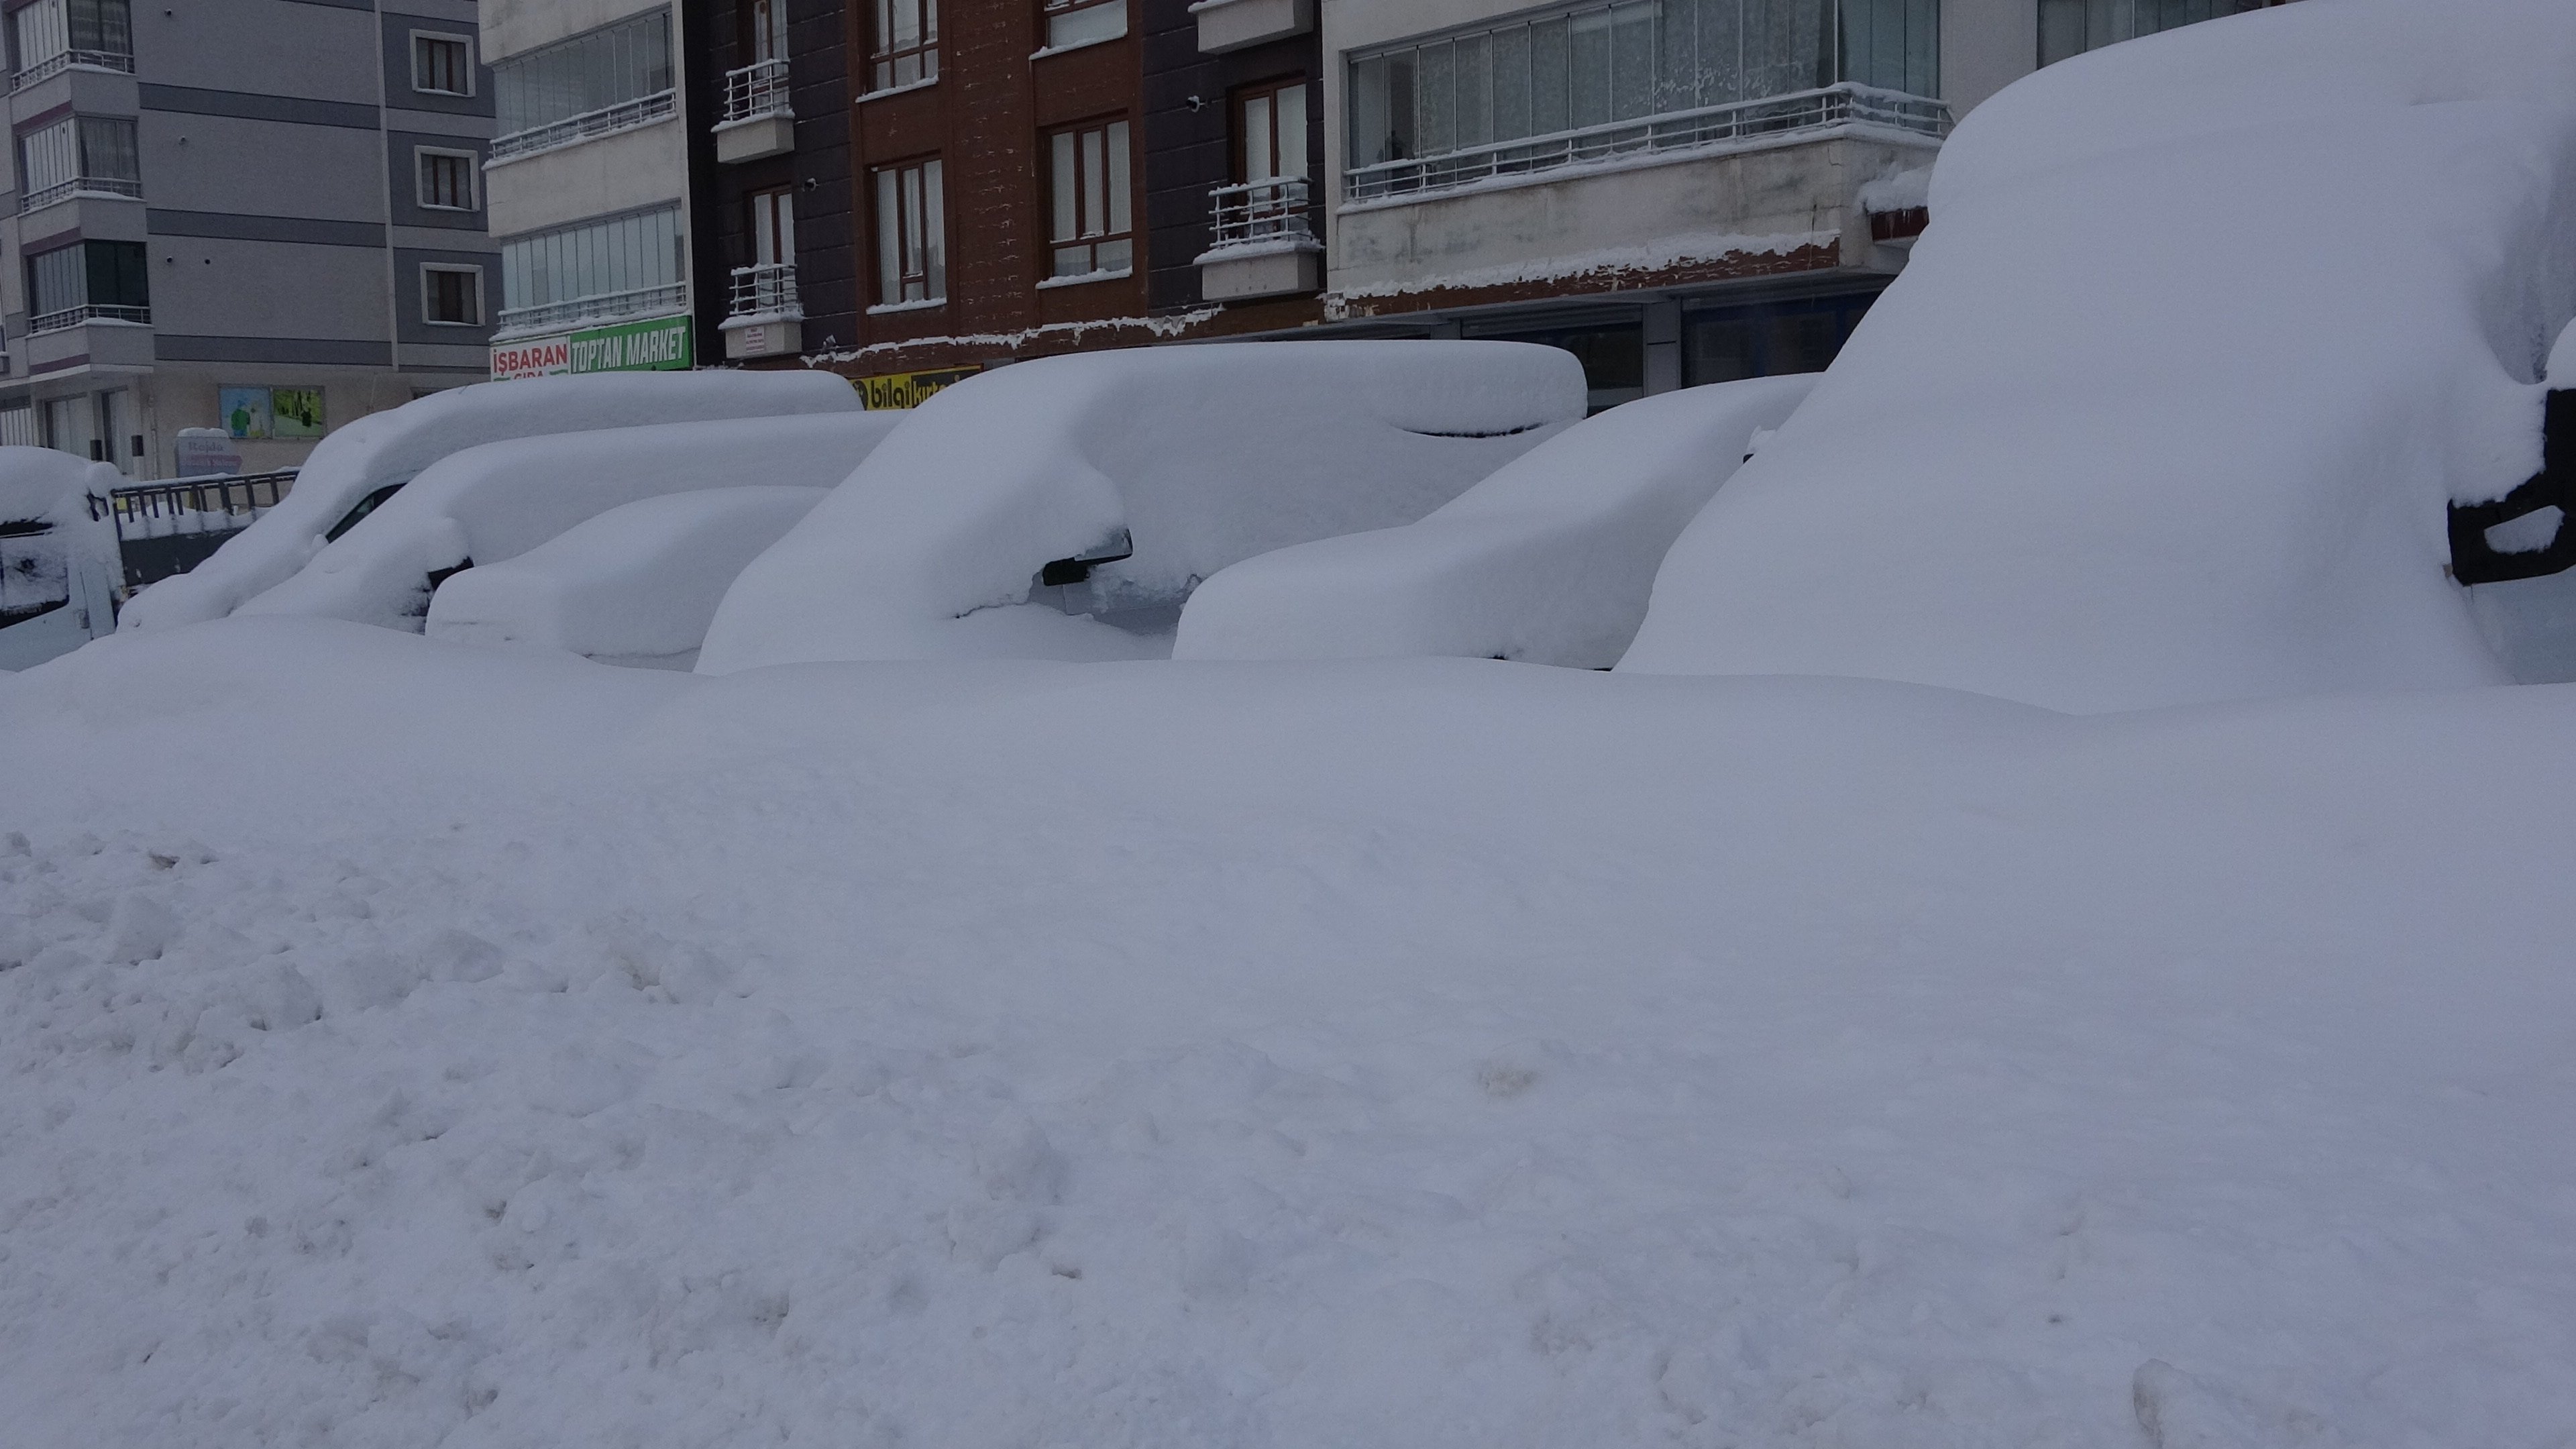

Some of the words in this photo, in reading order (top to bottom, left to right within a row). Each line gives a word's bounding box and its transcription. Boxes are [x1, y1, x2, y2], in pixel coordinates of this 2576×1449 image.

[494, 343, 568, 376] İŞBARAN
[572, 335, 623, 373] TOPTAN
[626, 326, 686, 366] MARKET
[871, 378, 910, 409] bilgi
